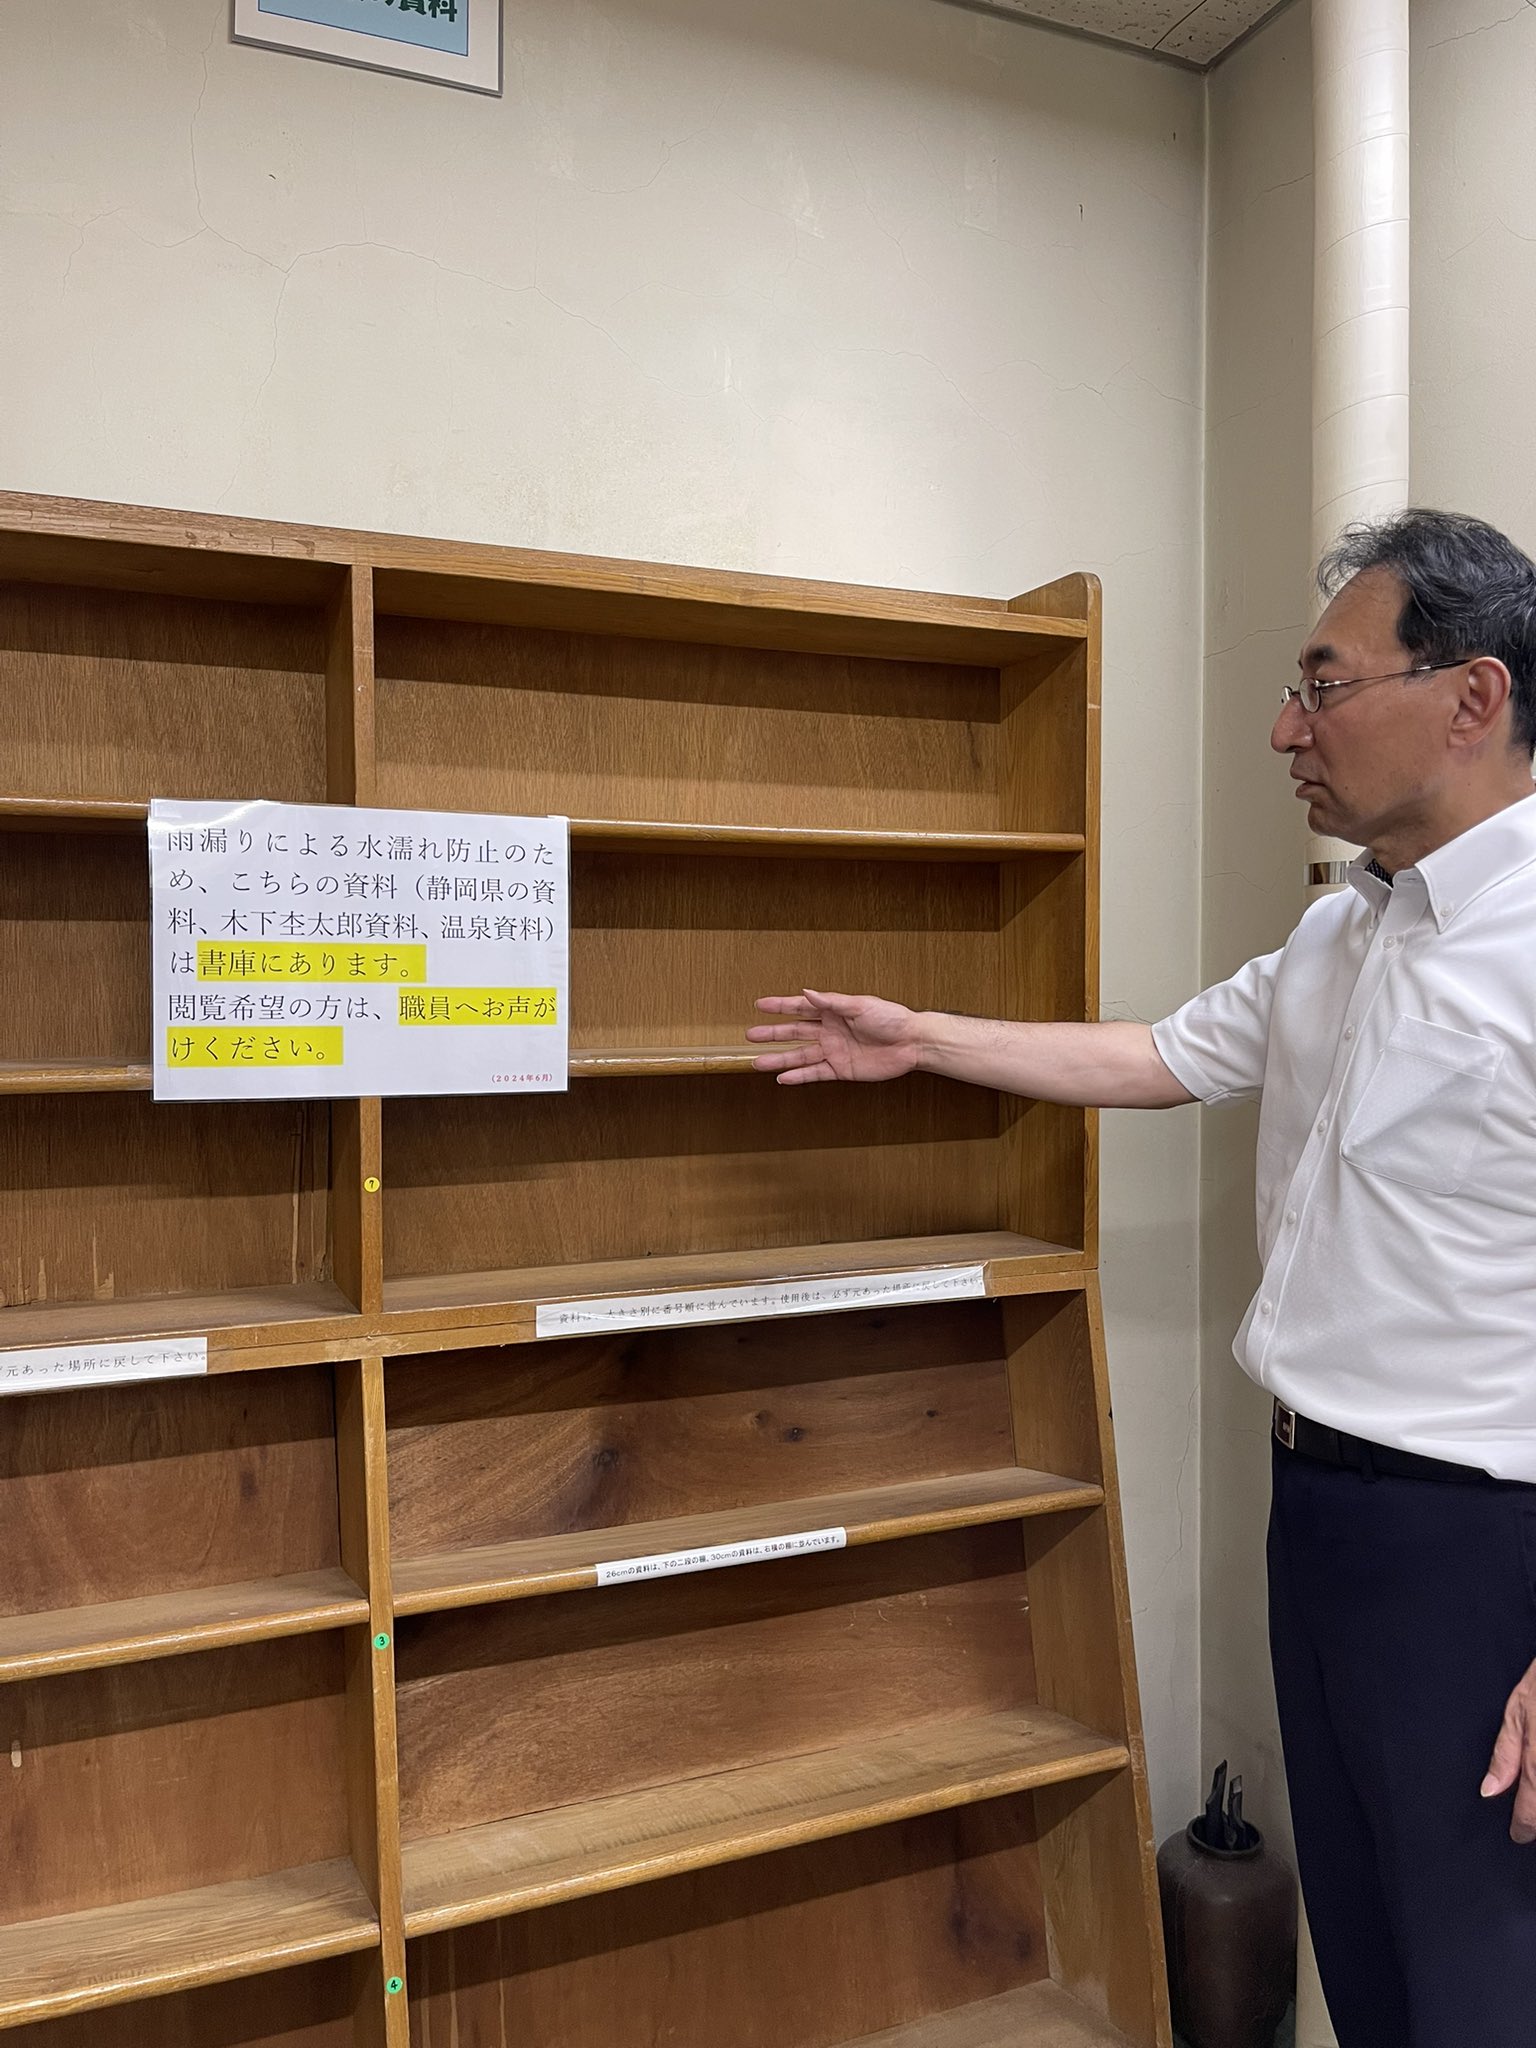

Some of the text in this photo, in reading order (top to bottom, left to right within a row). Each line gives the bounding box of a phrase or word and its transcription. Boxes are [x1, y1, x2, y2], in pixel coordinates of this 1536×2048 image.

[168, 828, 554, 866] 雨漏りによる水濡れ防止のた
[167, 908, 554, 942] 料、木下杢太郎資料、温泉資料）
[171, 949, 409, 978] は書庫にあります。
[168, 994, 556, 1021] 閲覧希望の方は、職員へお声が
[172, 1036, 325, 1062] けください。
[0, 1351, 206, 1378] 元あった場所に戻して下さい。
